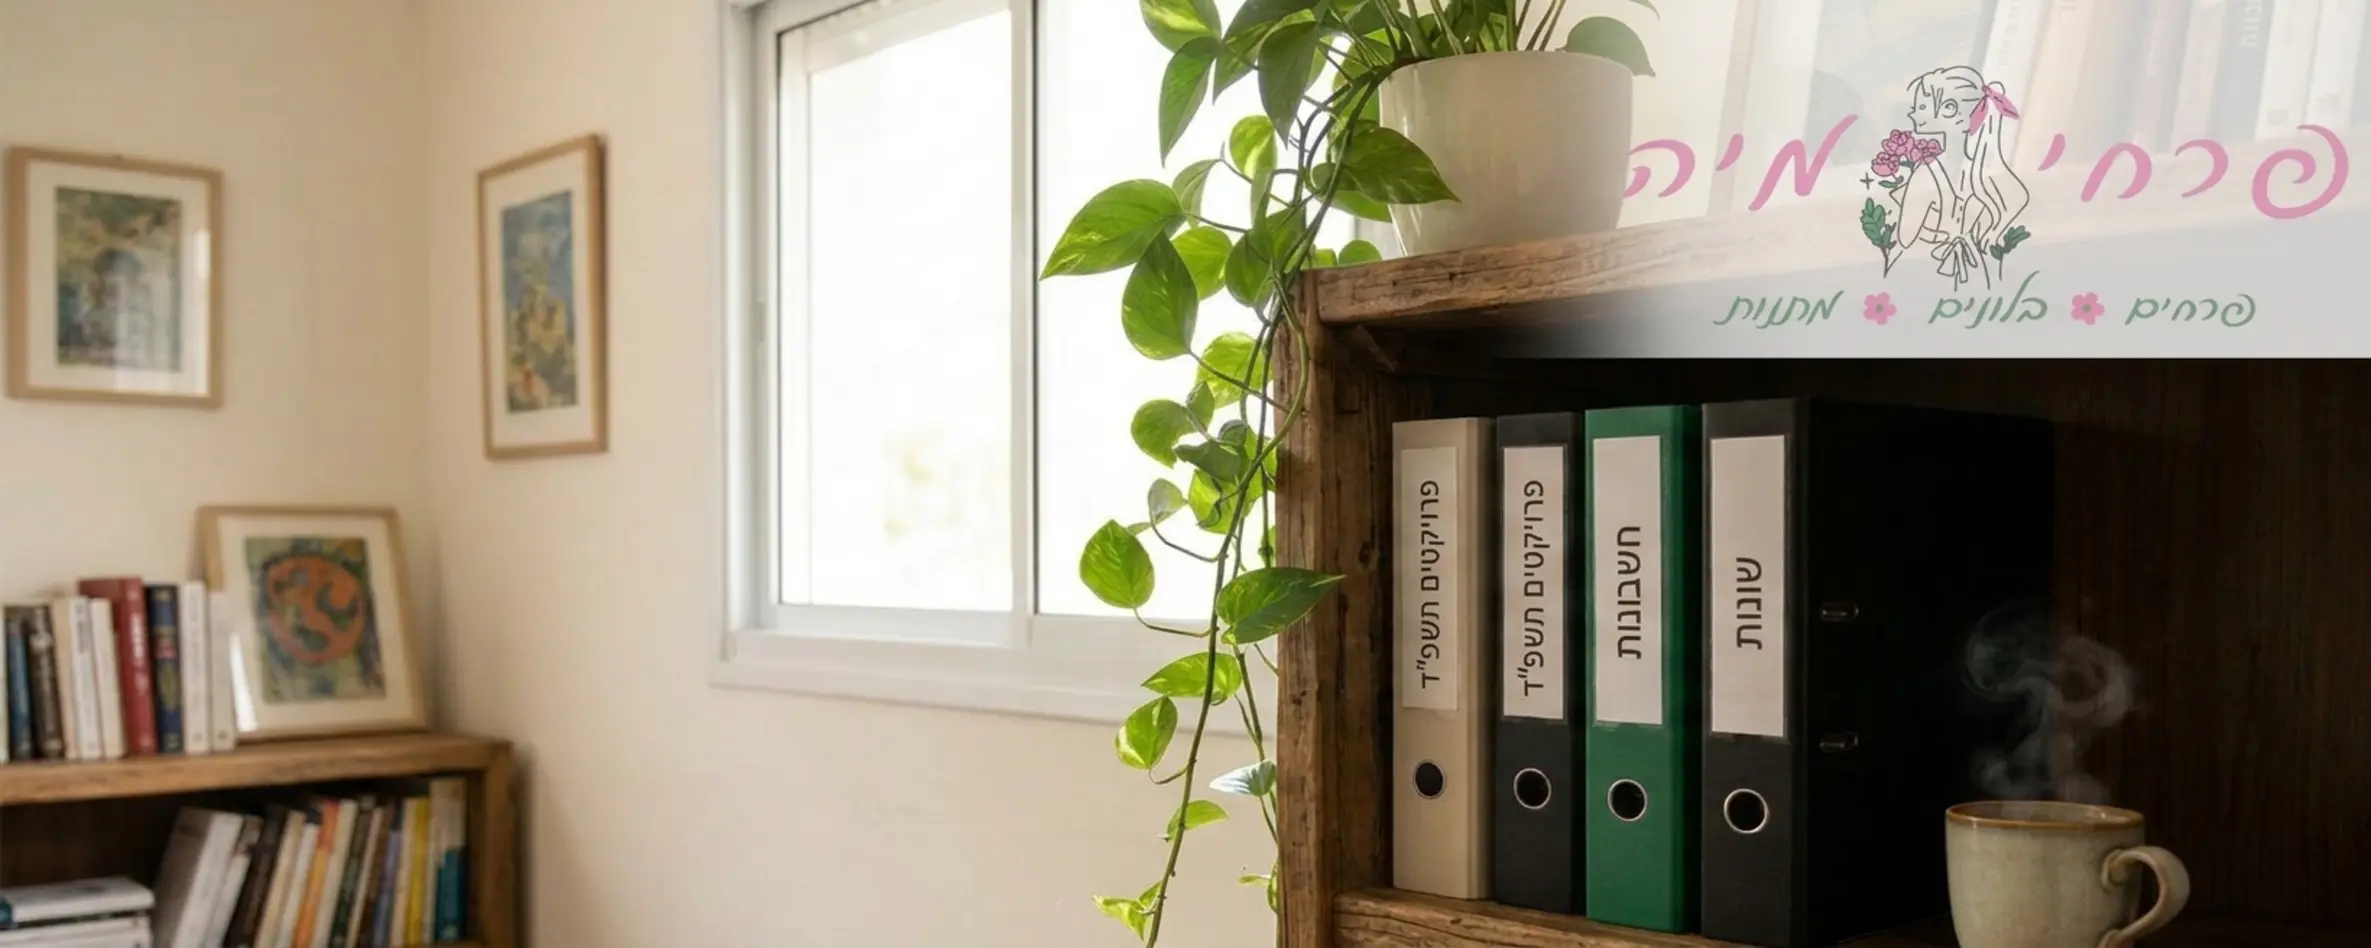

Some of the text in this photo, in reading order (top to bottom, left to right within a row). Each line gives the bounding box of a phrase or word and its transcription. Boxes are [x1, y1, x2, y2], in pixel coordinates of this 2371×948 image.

[1419, 480, 1446, 592] פרויקטים
[1523, 480, 1551, 597] פרויקטים
[1616, 526, 1642, 660] חשבונות
[1735, 557, 1763, 650] שונות
